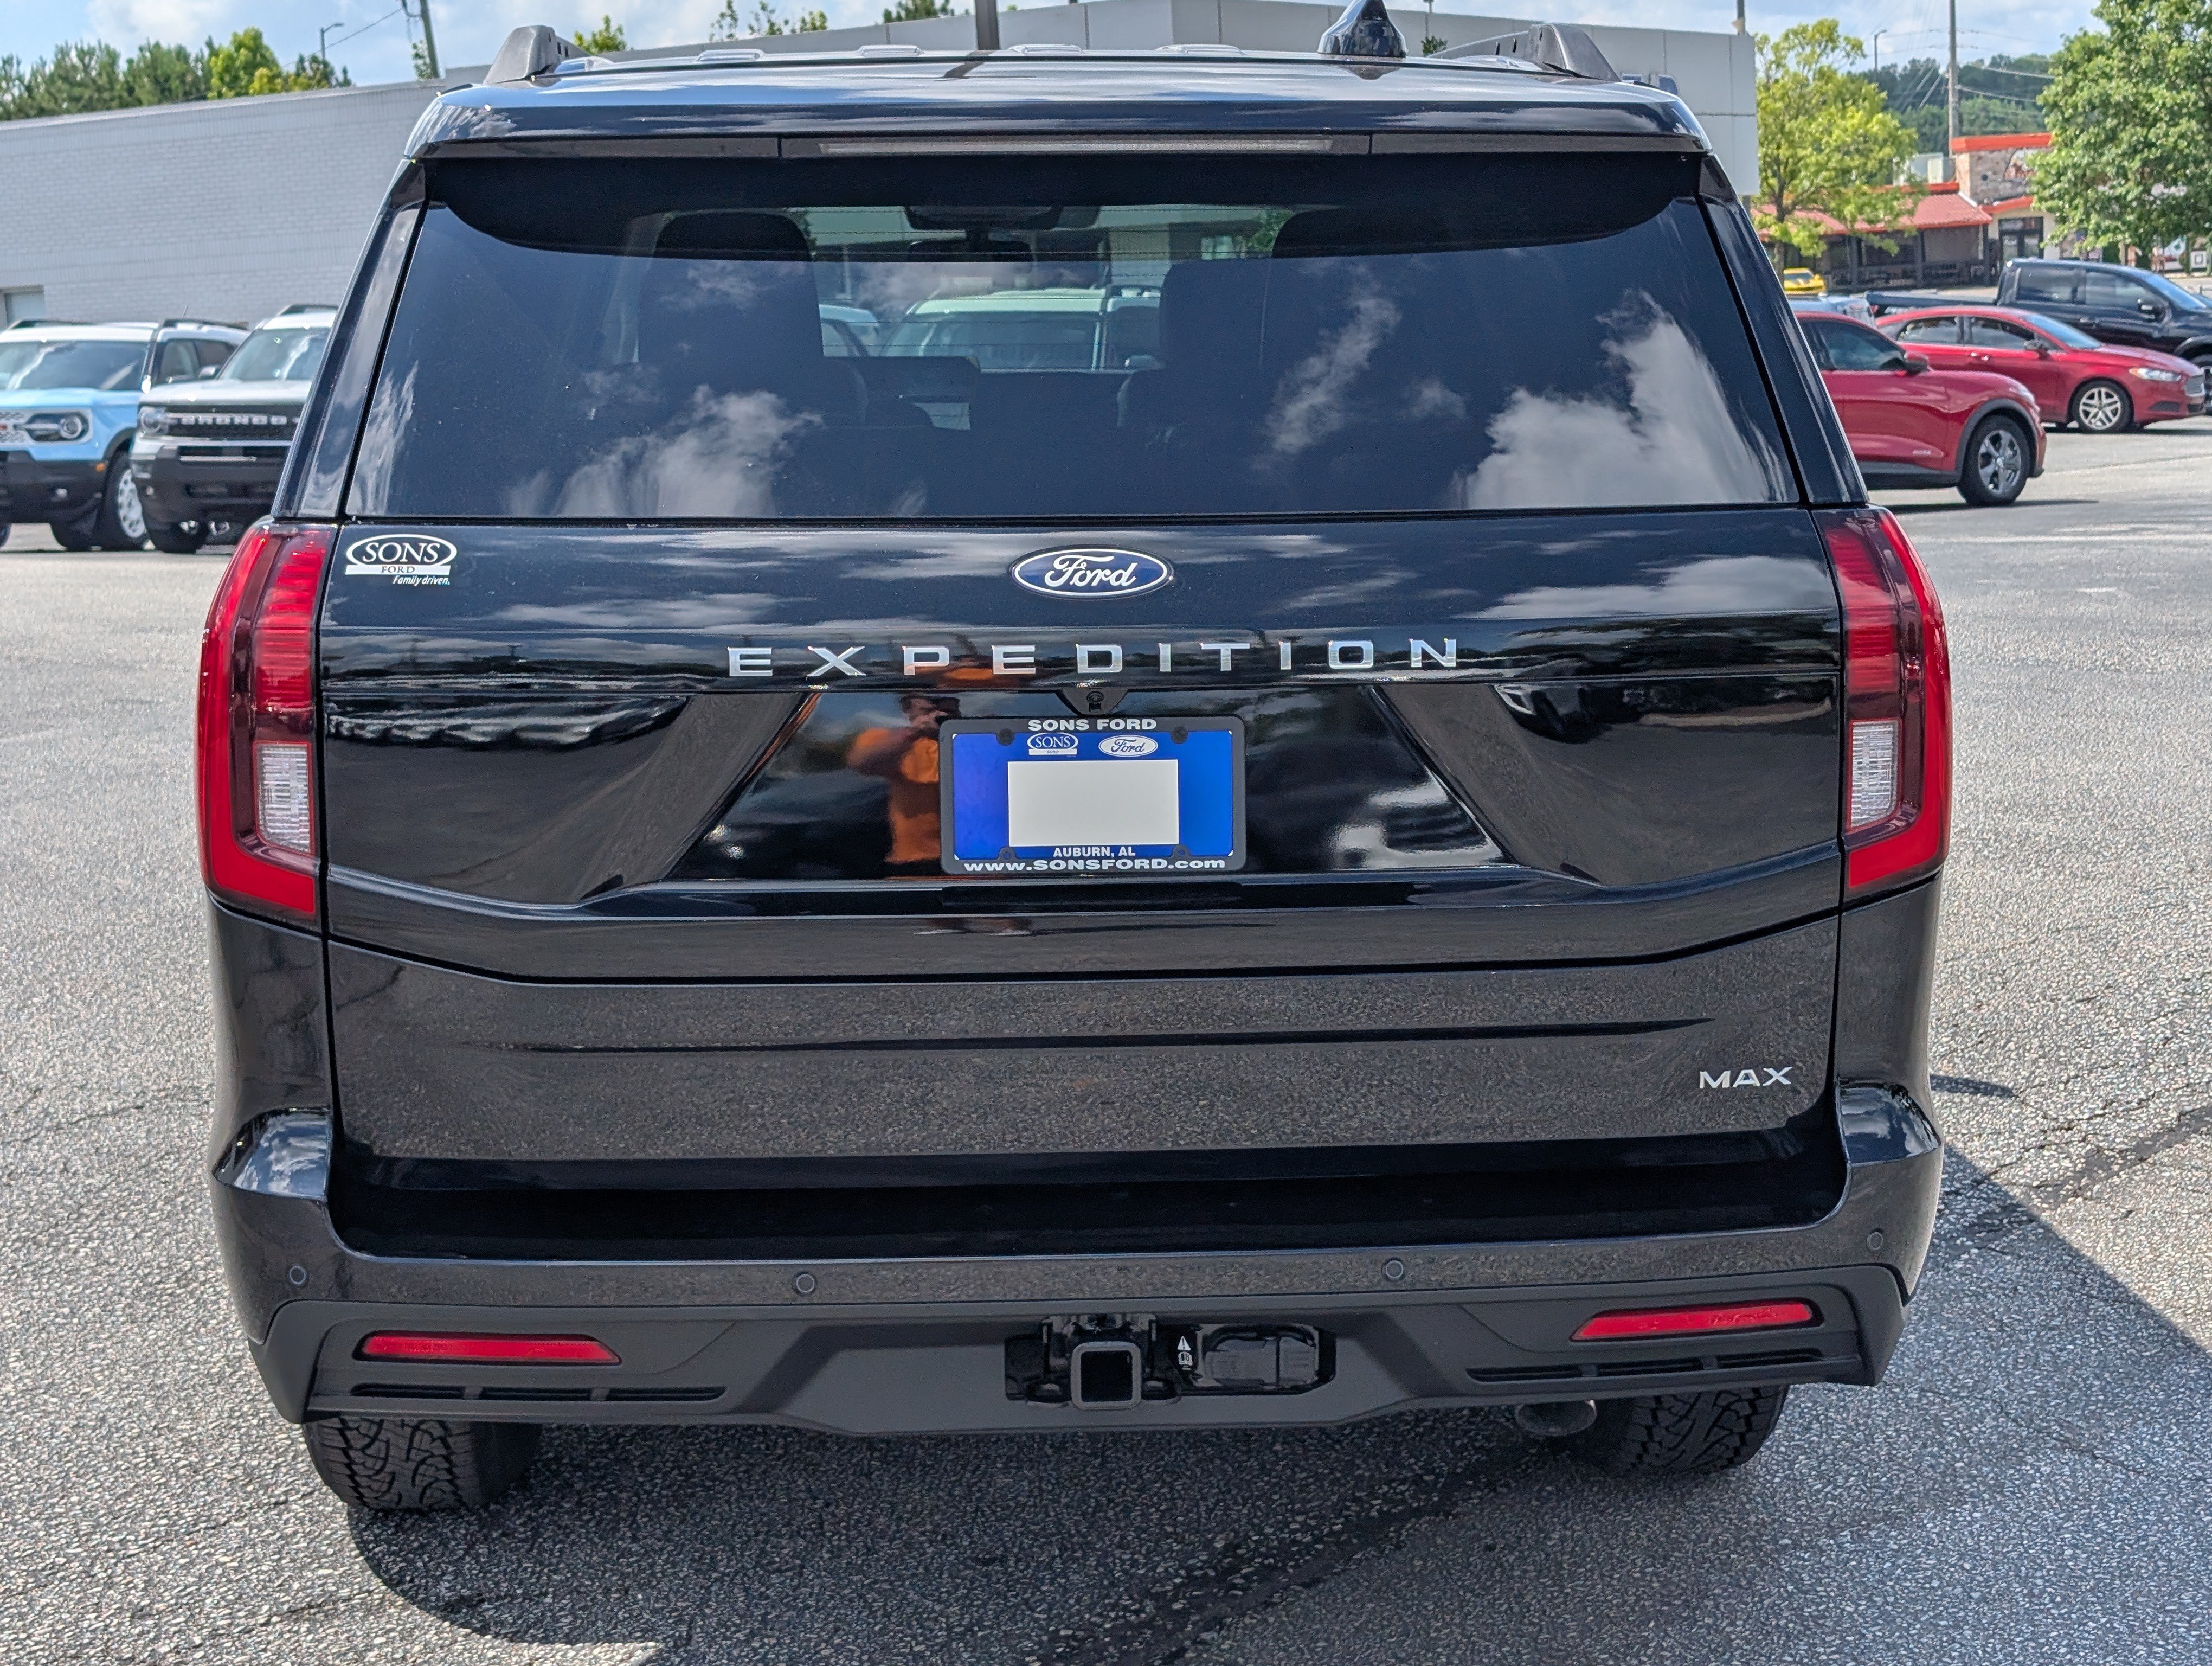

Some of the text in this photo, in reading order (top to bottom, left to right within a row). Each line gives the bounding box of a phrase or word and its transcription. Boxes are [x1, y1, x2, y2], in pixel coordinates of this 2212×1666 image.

[363, 542, 440, 562] SONS
[1044, 555, 1138, 587] Ford
[393, 575, 451, 586] Family driven.
[728, 638, 1457, 677] EXPEDITION
[1028, 719, 1157, 731] SONS FORD
[1035, 736, 1071, 748] SONS
[1111, 738, 1146, 753] Ford
[1053, 847, 1136, 858] AUBURN, AL
[964, 858, 1225, 872] www.SONSFORD.com
[1699, 1066, 1792, 1089] MAX
